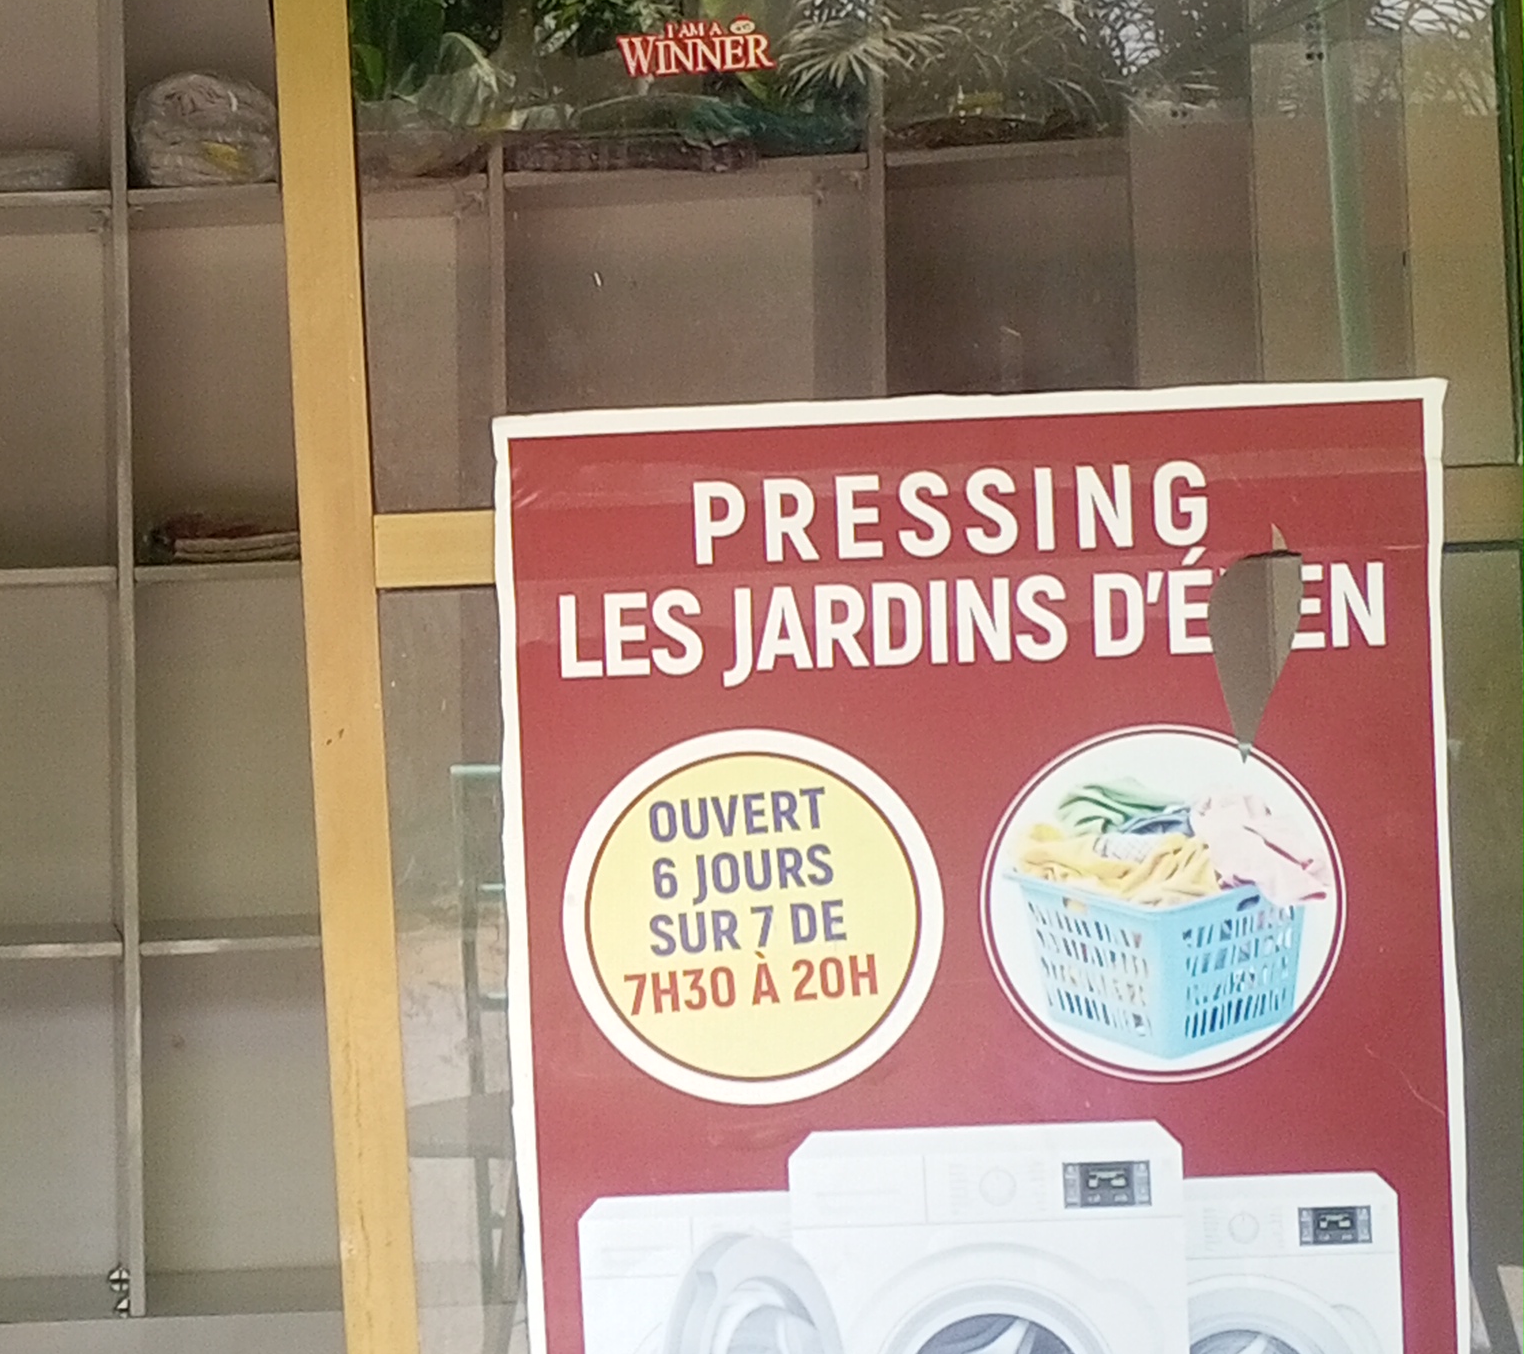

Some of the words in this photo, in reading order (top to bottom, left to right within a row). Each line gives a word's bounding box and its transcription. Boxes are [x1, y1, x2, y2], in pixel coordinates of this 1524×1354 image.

[618, 34, 774, 76] WINNER
[667, 23, 674, 38] I
[679, 22, 705, 37] AM
[709, 21, 723, 36] A
[692, 460, 1209, 565] PRESSING
[558, 589, 704, 678] LES
[722, 574, 1068, 688] JARDINS
[1092, 546, 1386, 659] D'ÉEN
[649, 786, 826, 843] OUVERT
[652, 857, 678, 899] 6
[692, 843, 834, 906] JOURS
[649, 909, 742, 957] SUR
[750, 905, 774, 948] 7
[789, 899, 847, 945] DE
[623, 965, 736, 1016] 7H30
[751, 950, 780, 1006] À
[791, 953, 878, 1002] 20H
